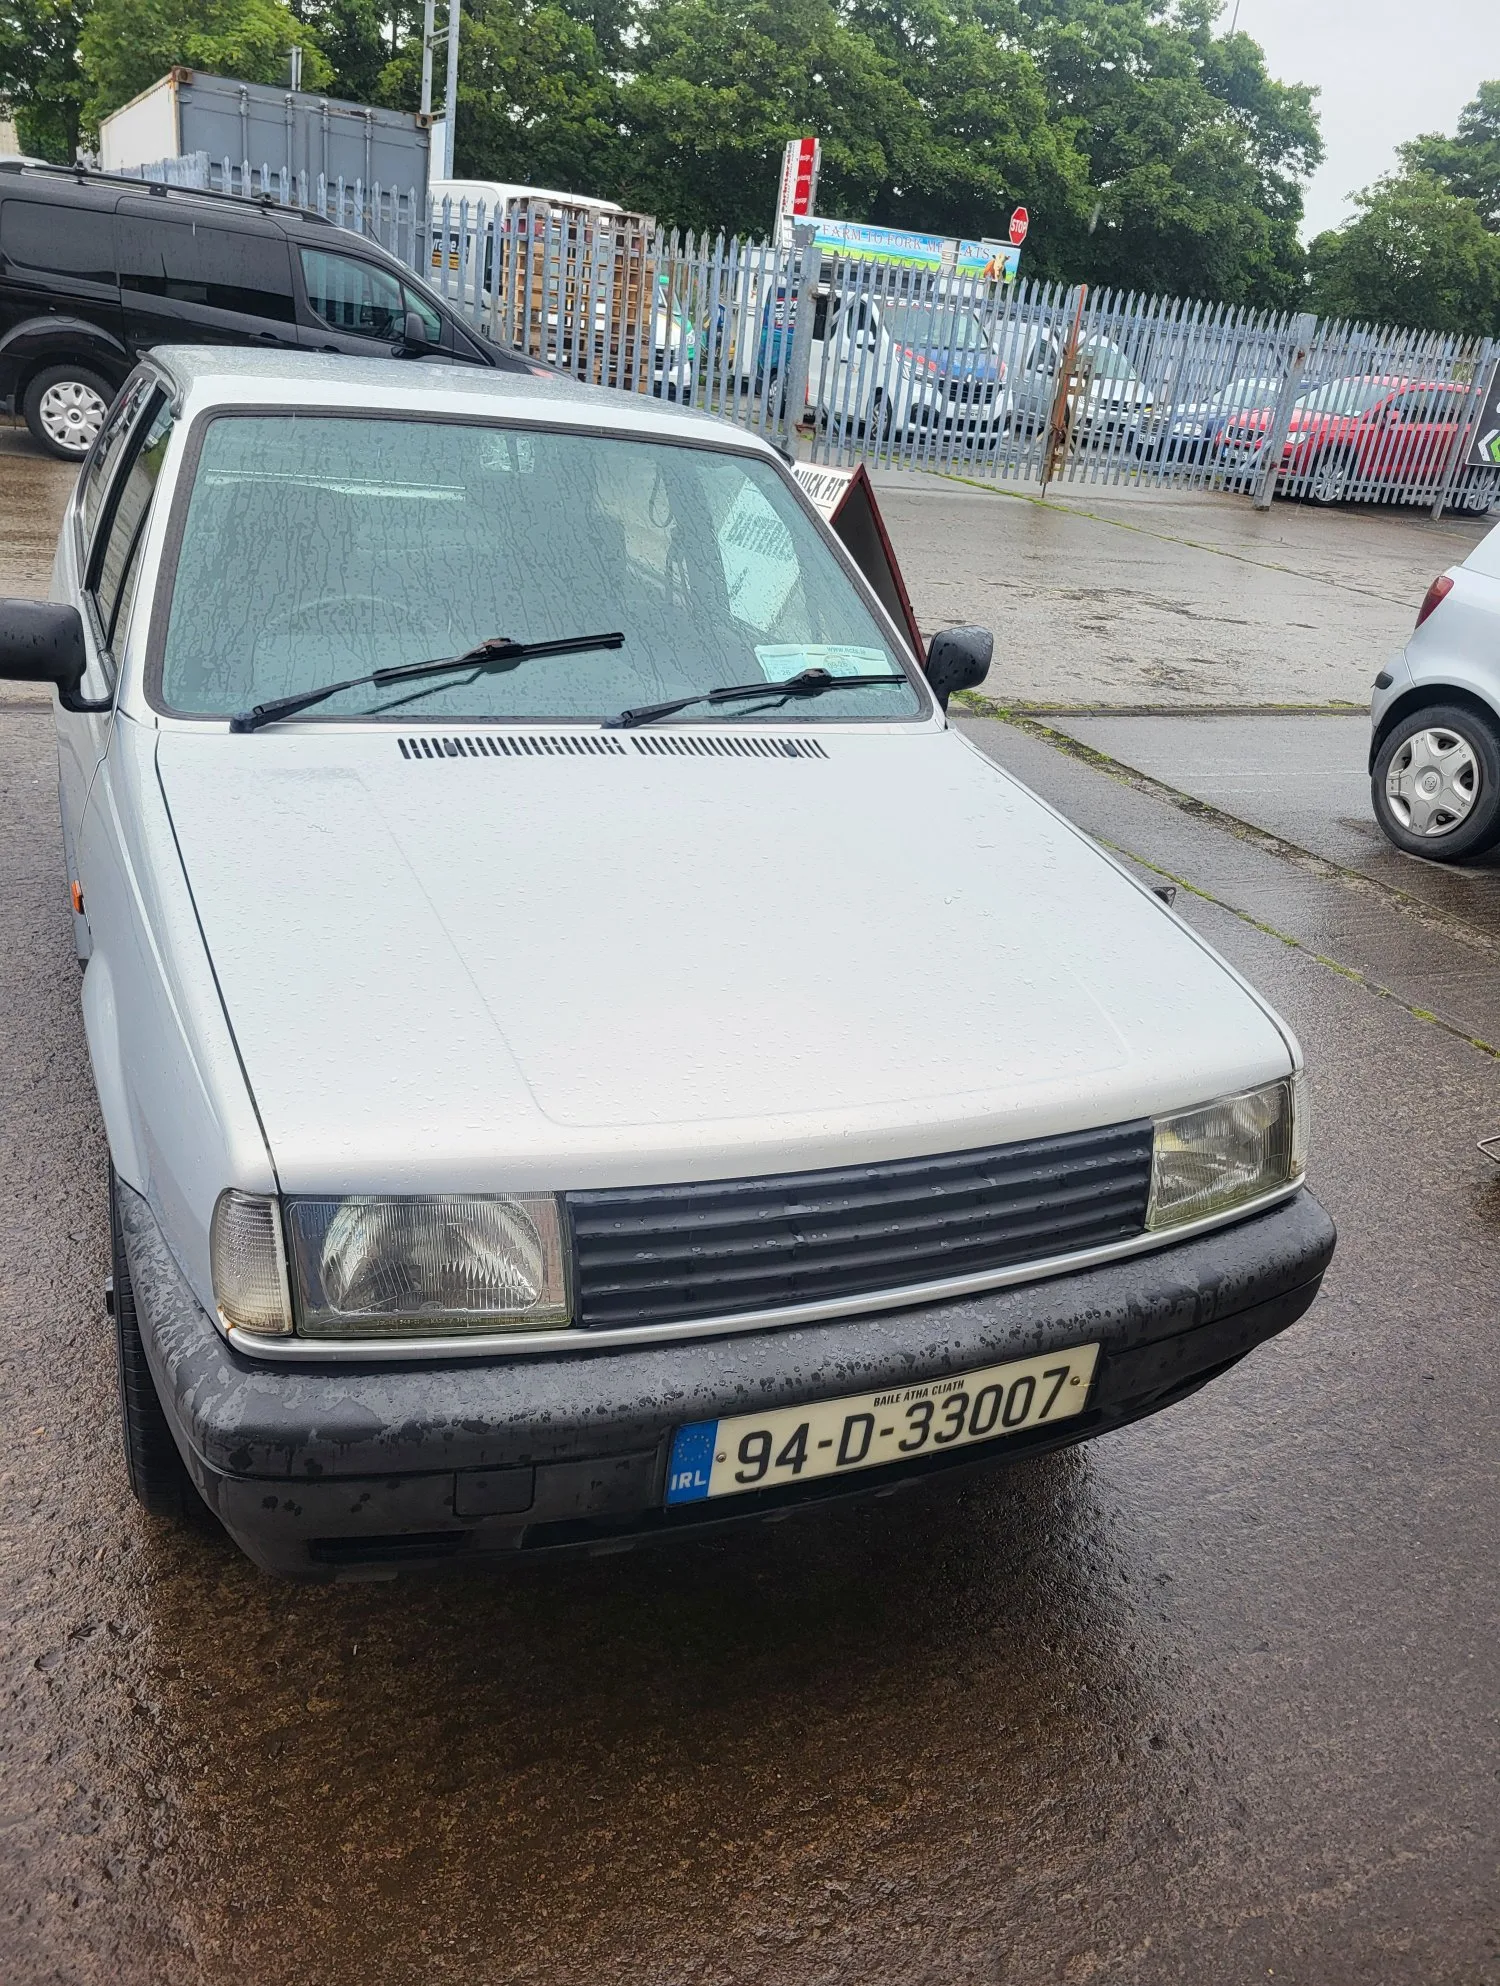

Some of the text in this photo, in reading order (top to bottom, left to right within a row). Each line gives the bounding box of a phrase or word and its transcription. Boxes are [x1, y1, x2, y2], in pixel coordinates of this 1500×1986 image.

[822, 224, 861, 241] FARM
[866, 230, 884, 245] TO
[887, 234, 922, 250] FORK
[1010, 218, 1027, 234] STOP
[873, 1379, 965, 1407] BAILE ÁTHA CLIATH
[734, 1365, 1070, 1484] 94-D-33007
[670, 1470, 707, 1491] IRL
